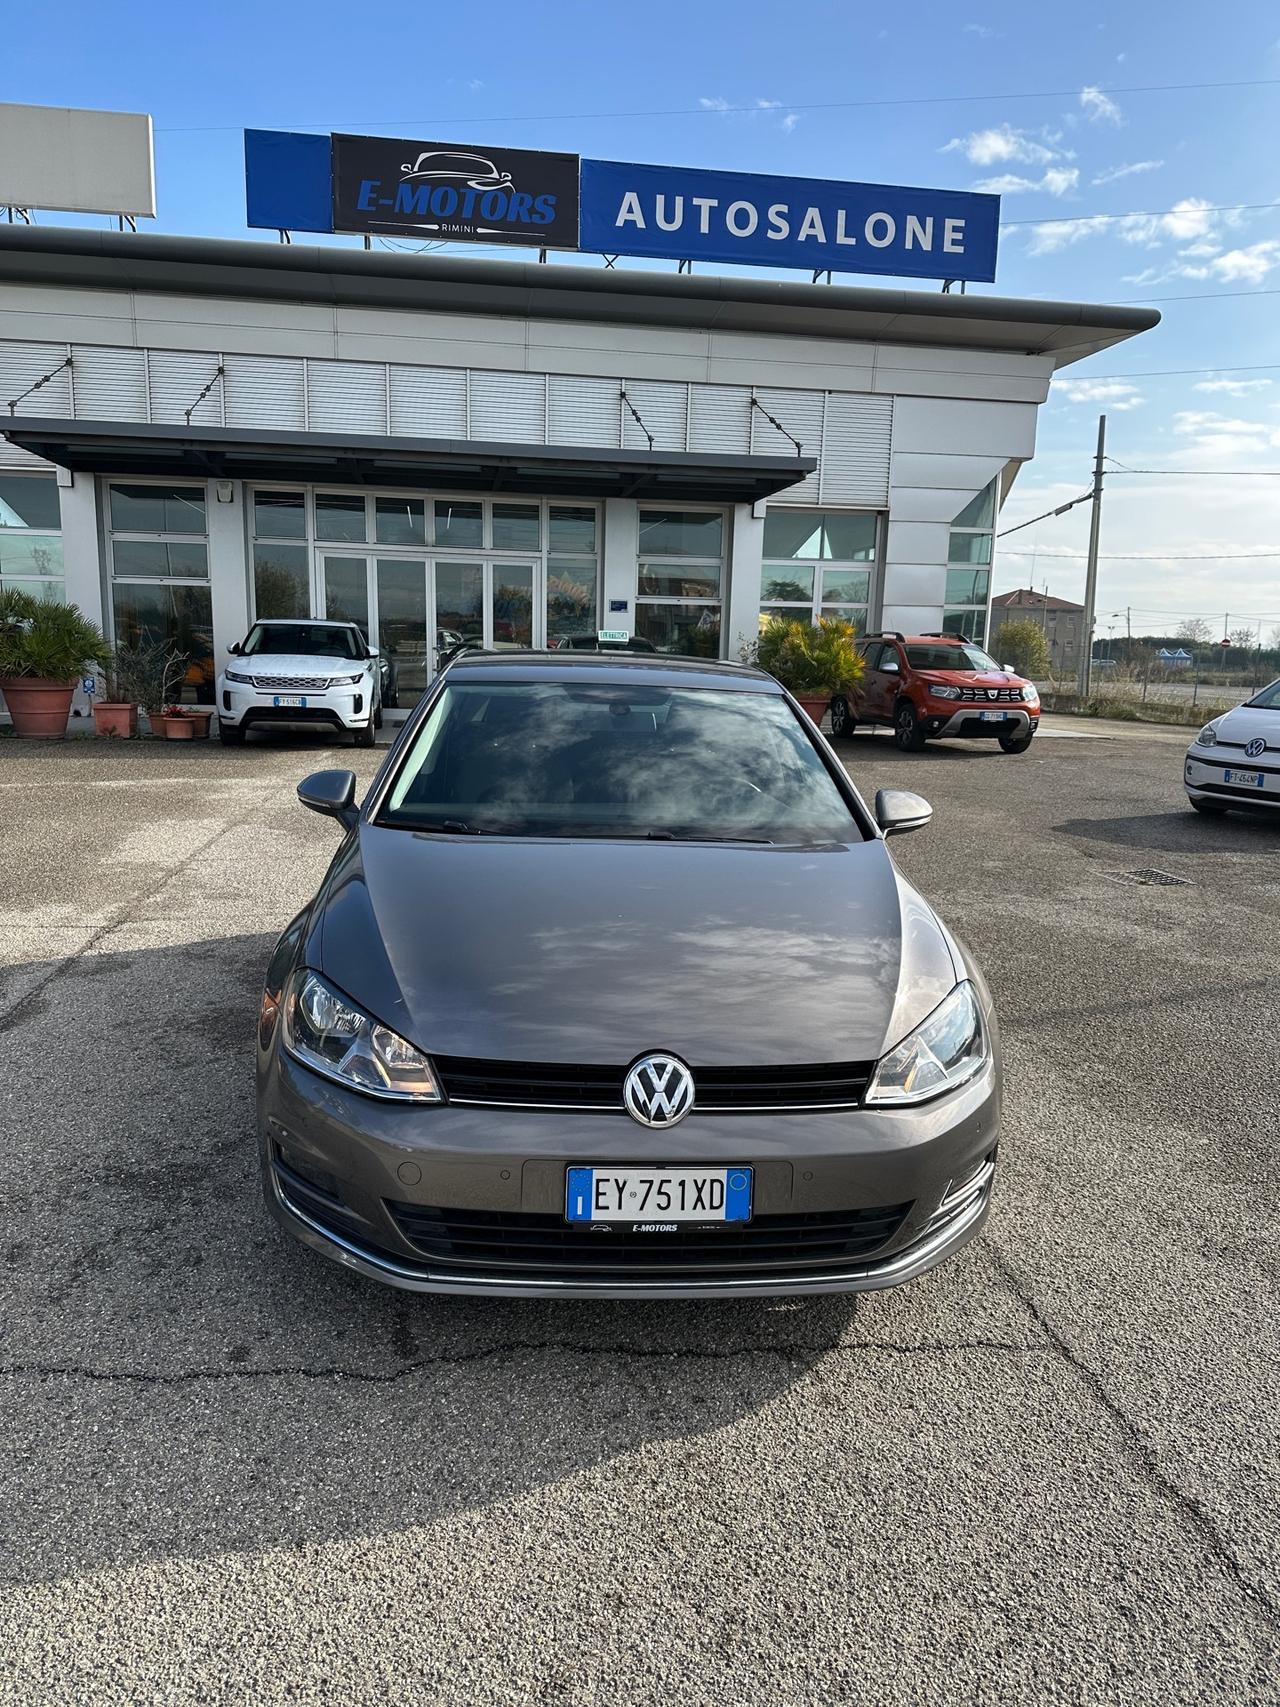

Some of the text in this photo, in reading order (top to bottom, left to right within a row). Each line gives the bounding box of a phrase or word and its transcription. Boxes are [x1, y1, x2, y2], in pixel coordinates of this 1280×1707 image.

[357, 179, 557, 225] E-MOTORS
[441, 223, 475, 234] RIMINI
[615, 191, 966, 253] AUTOSALONE
[632, 1224, 678, 1232] E-MOTORS
